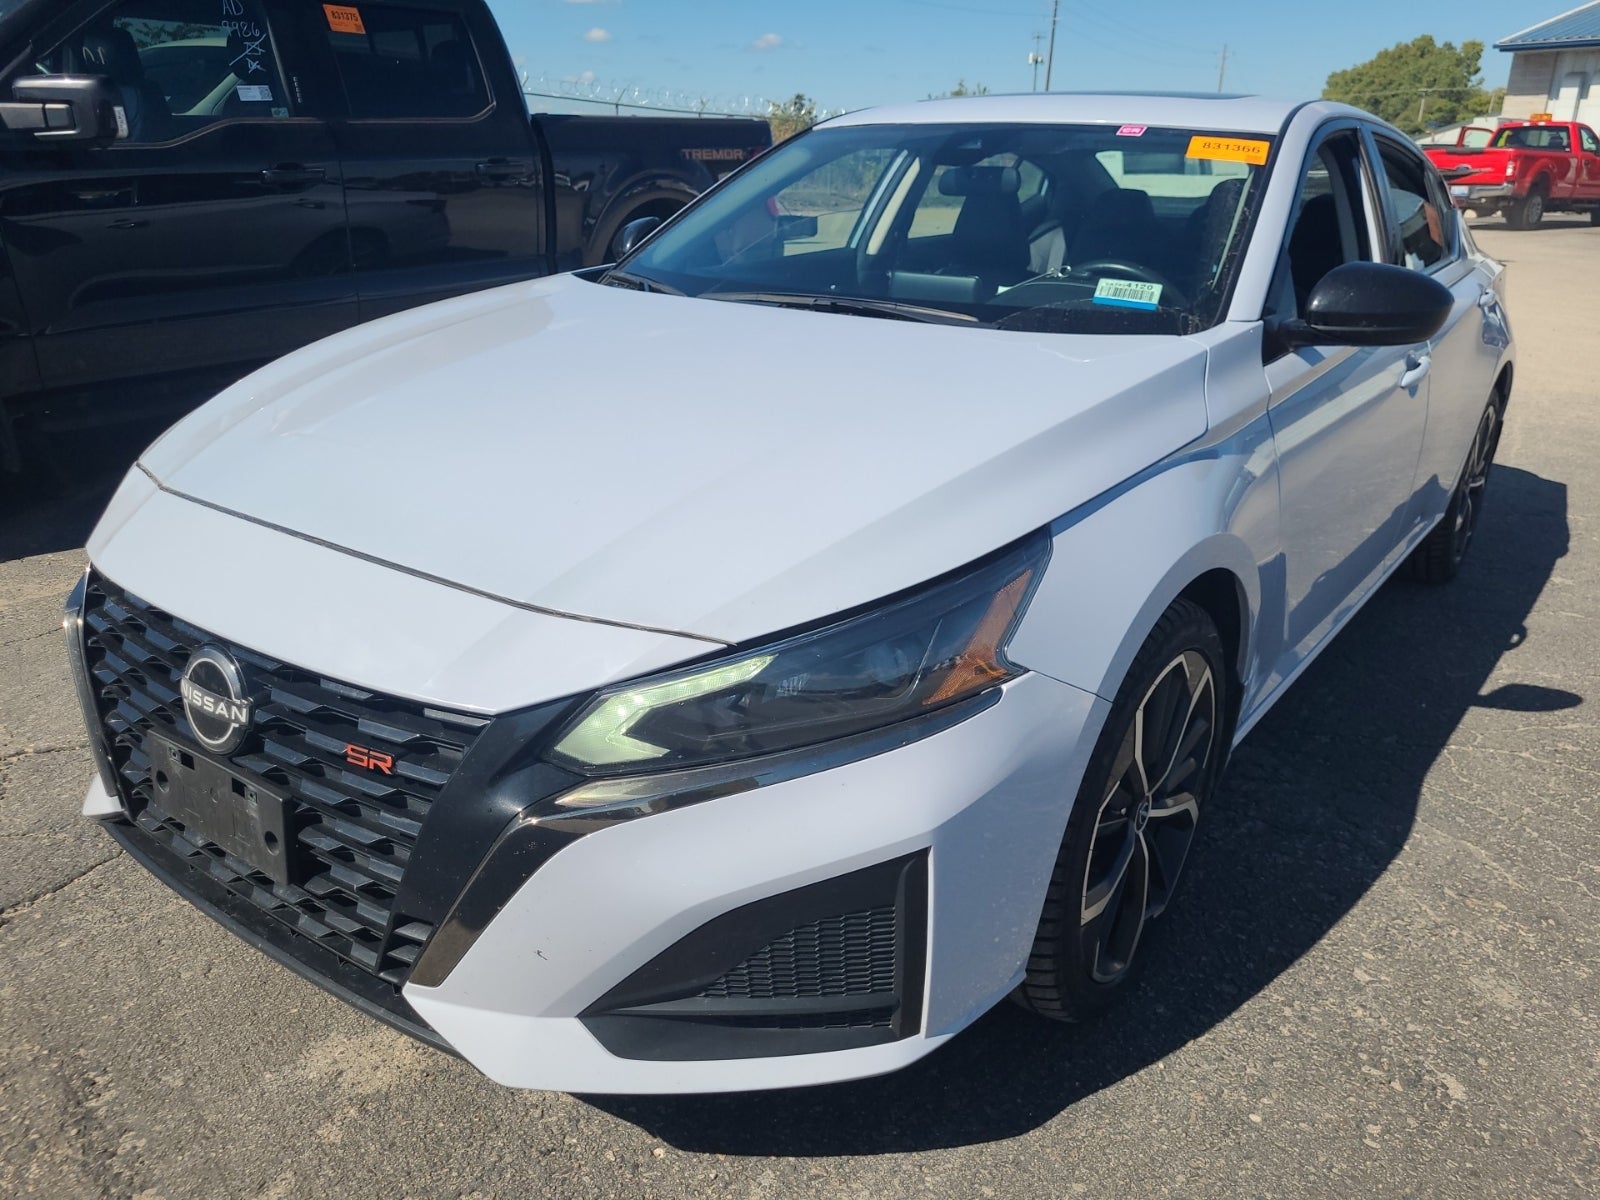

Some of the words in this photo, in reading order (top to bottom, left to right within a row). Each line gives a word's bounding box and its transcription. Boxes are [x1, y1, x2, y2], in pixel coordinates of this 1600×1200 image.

[681, 148, 744, 160] TREMOR
[1202, 142, 1261, 153] 831366
[181, 682, 247, 723] NISSAN
[346, 744, 393, 776] SR
